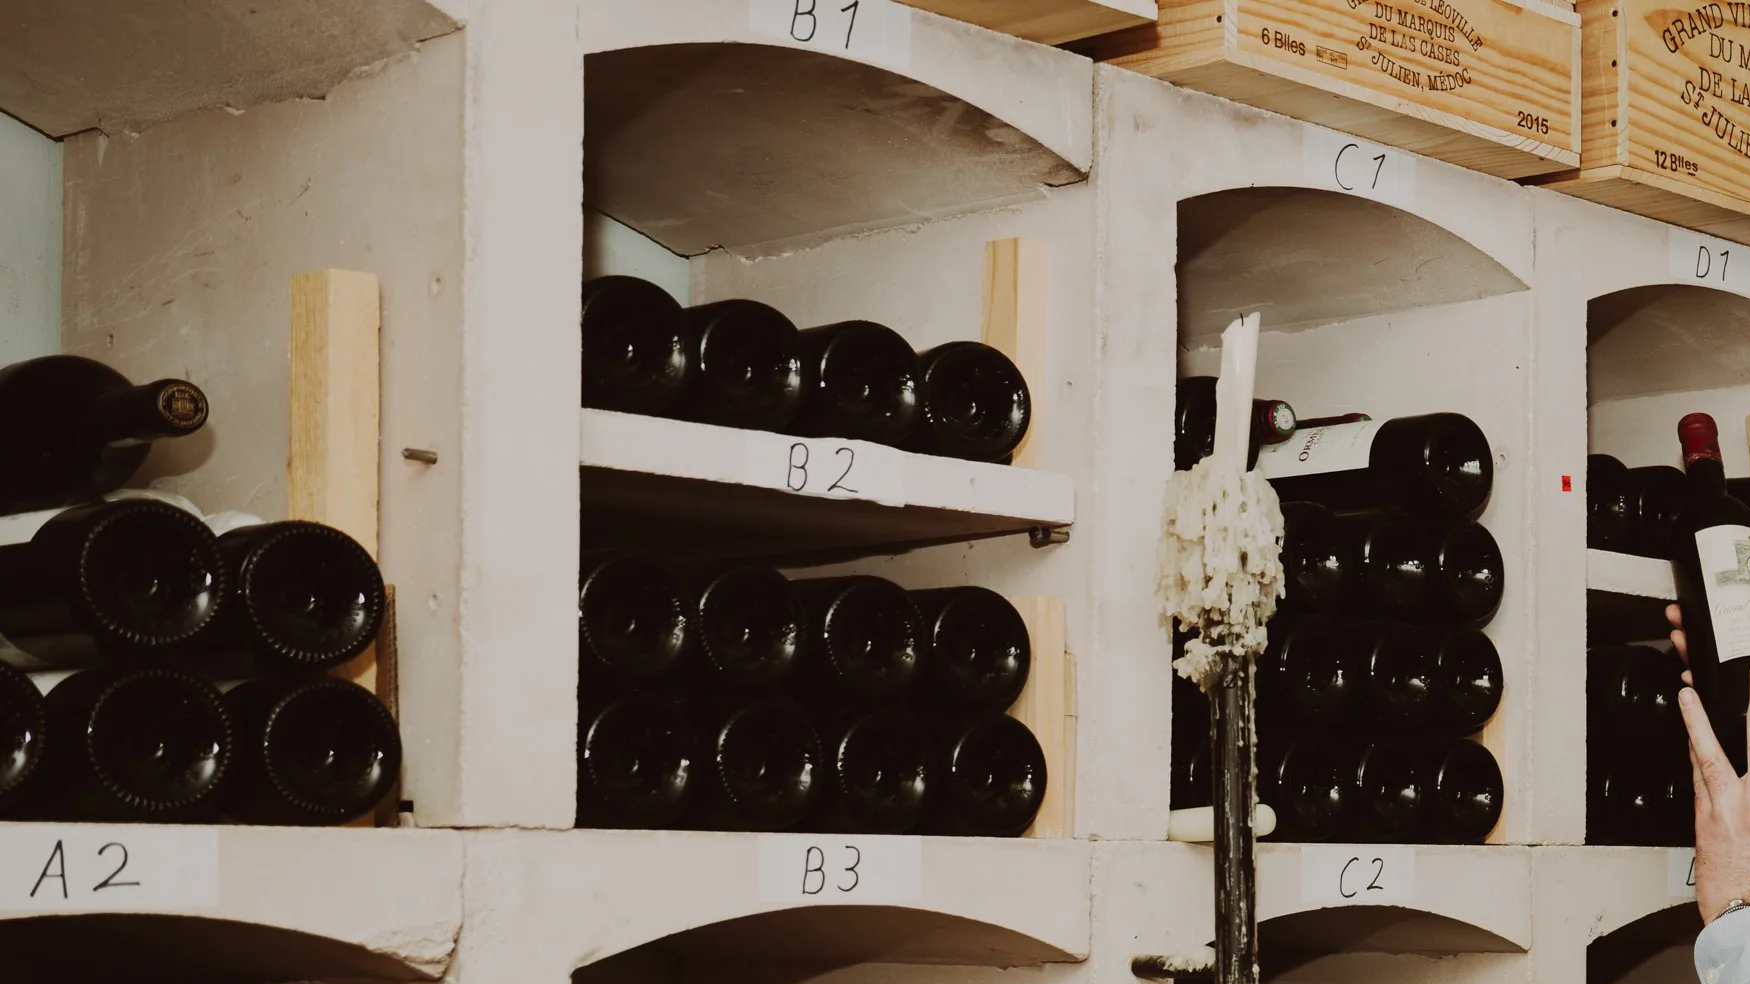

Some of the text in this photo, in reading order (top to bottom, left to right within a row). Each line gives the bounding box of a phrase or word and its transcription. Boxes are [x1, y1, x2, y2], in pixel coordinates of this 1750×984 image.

[1261, 28, 1270, 45] 6
[1375, 1, 1455, 43] DU MARQUIS
[1662, 3, 1724, 53] GRAND
[1369, 23, 1460, 67] DE LAS CASES
[1709, 32, 1733, 63] DU
[1372, 51, 1424, 92] JULIEN,
[1427, 68, 1472, 92] MÉDOC
[1699, 67, 1724, 99] DE
[1517, 111, 1550, 135] 2015
[1334, 143, 1387, 190] C1
[1654, 150, 1668, 170] 12
[1695, 245, 1730, 281] D1
[787, 441, 859, 495] B2
[30, 840, 140, 900] A2
[800, 844, 860, 896] B3
[1339, 856, 1386, 898] C2
